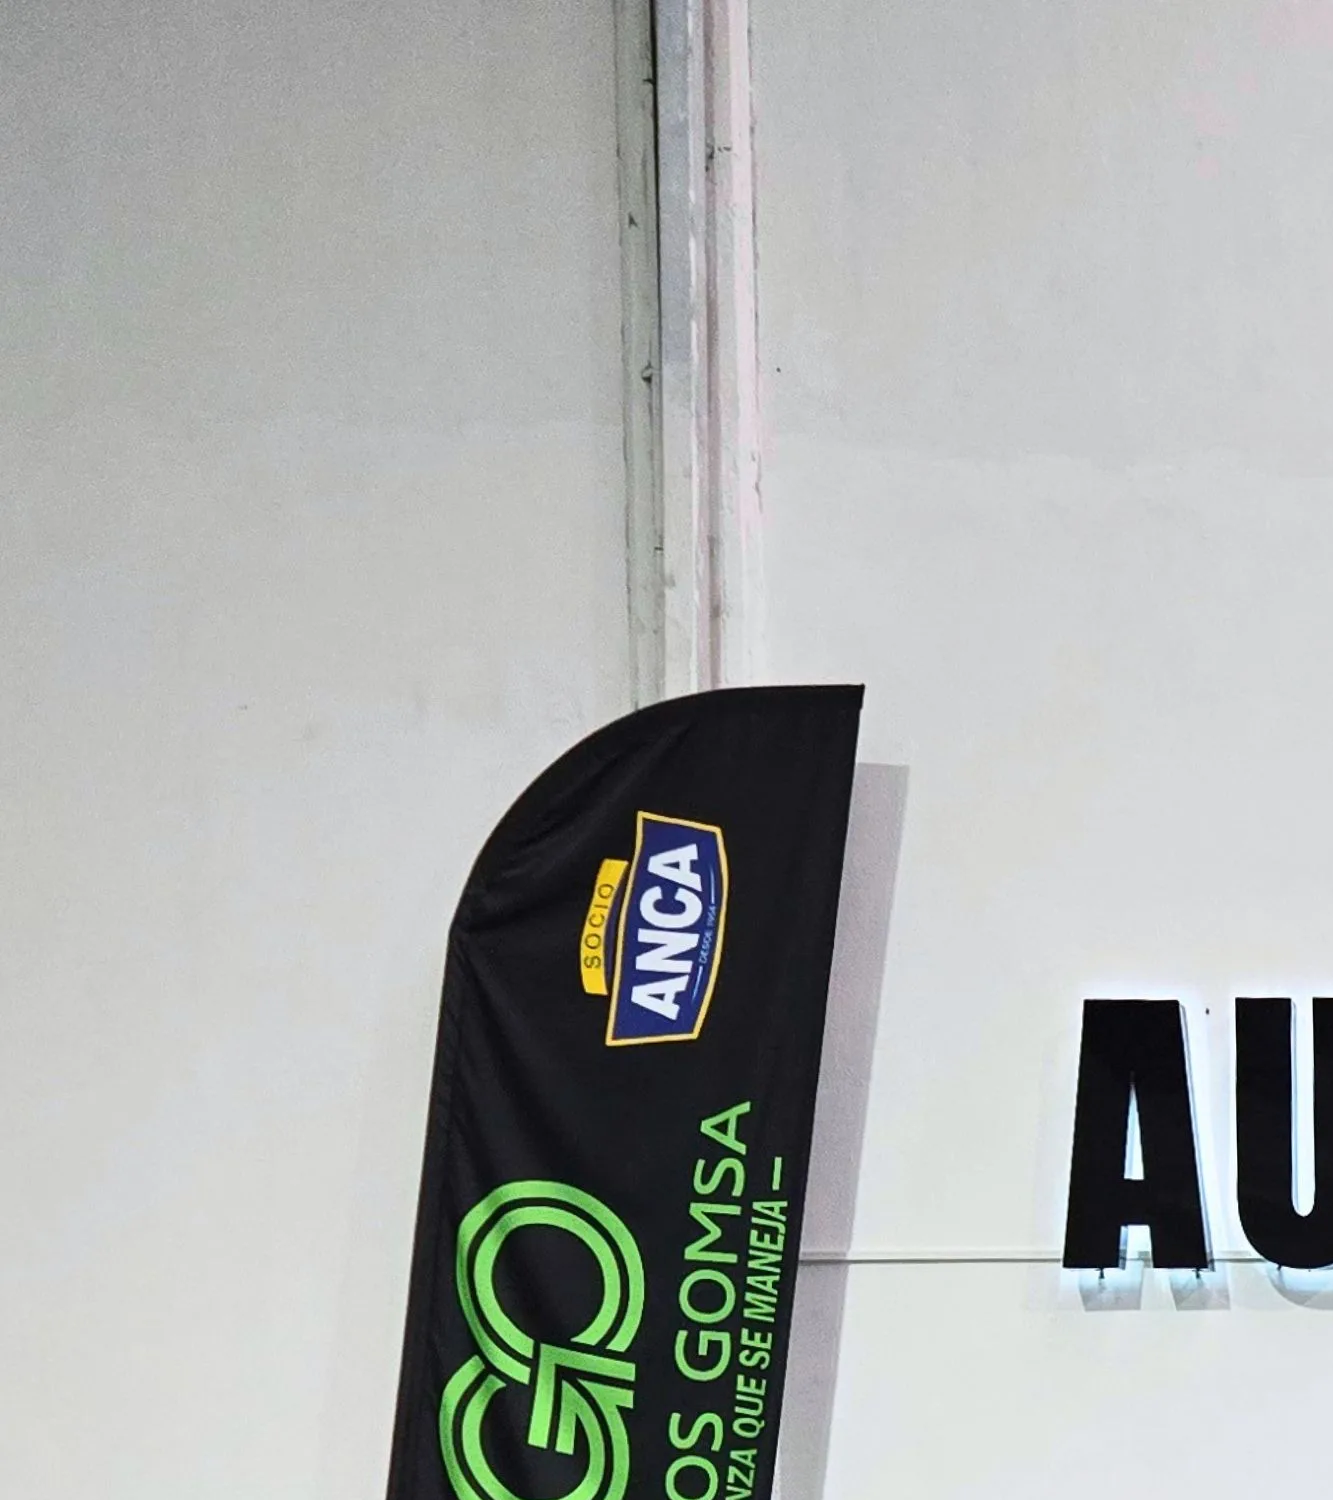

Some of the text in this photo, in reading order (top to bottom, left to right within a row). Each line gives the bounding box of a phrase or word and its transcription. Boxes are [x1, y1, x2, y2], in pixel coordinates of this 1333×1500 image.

[584, 882, 615, 969] SOCIO
[631, 843, 703, 1021] ANCA
[674, 1101, 750, 1382] GOMSA
[743, 1200, 788, 1323] MANEJA
[738, 1327, 772, 1369] SE
[732, 1374, 766, 1438] QUE
